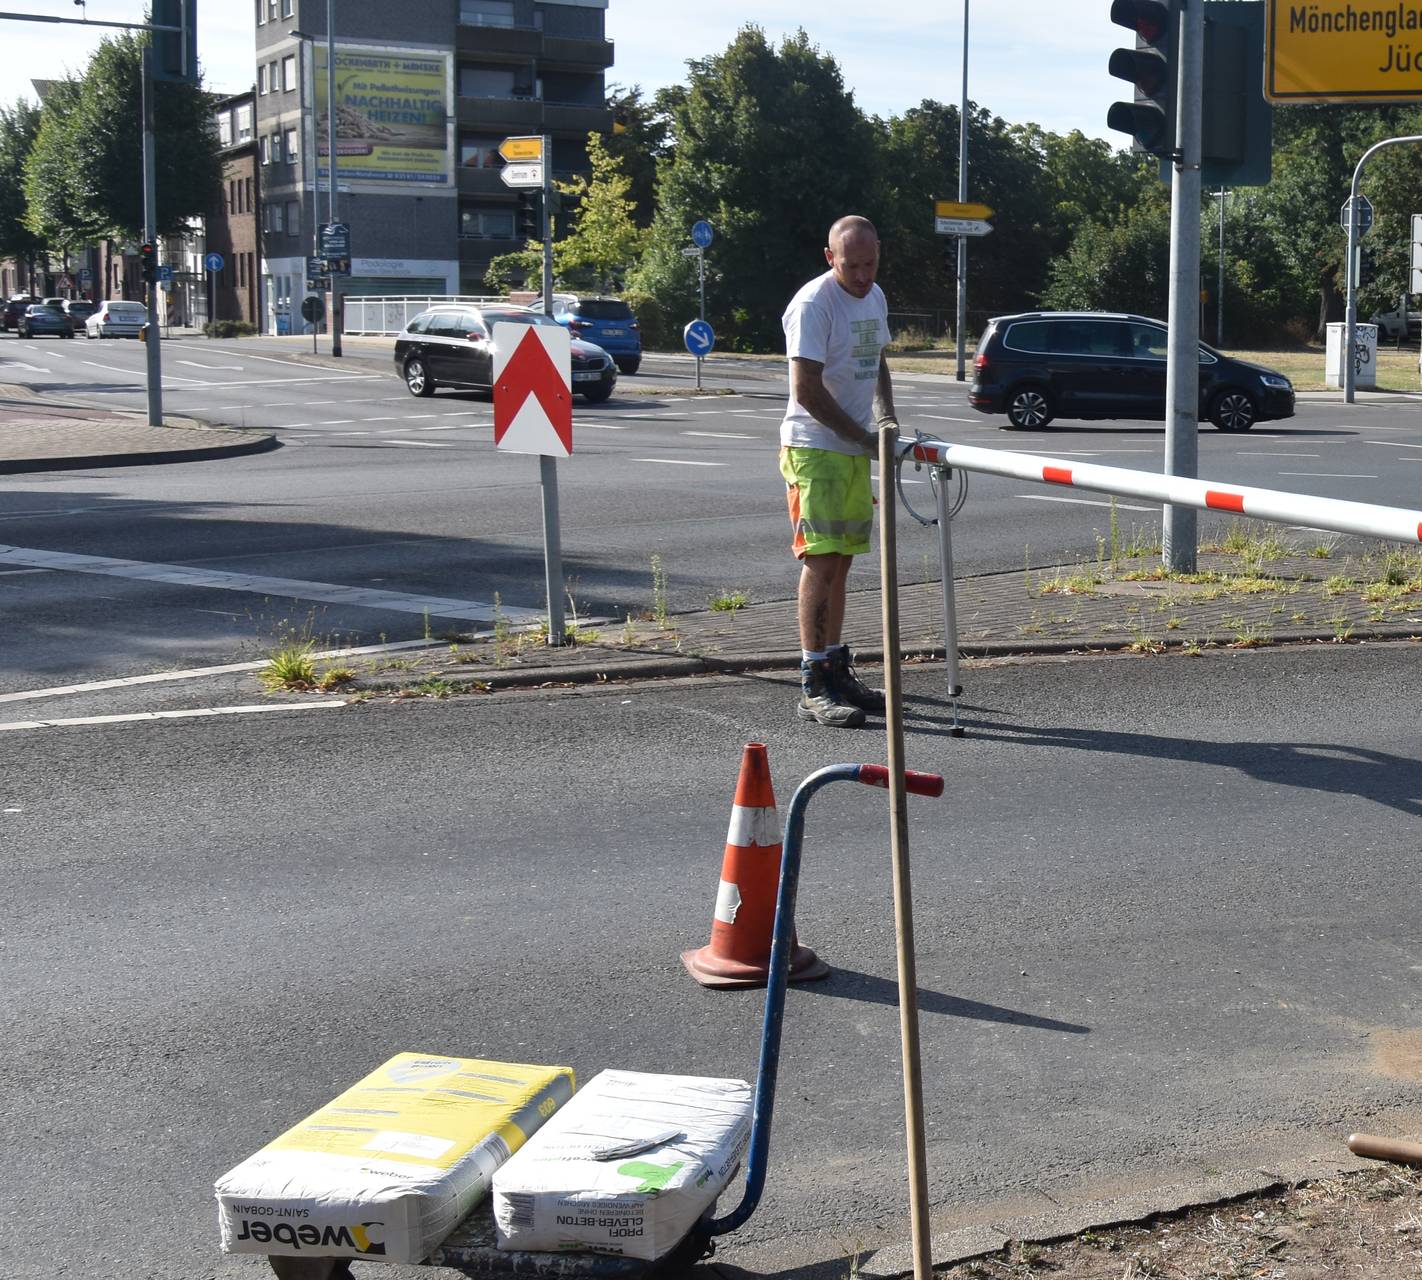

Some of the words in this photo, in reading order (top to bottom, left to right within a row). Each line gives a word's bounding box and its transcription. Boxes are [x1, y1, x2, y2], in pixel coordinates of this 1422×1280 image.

[344, 94, 442, 111] NACHHALTIG
[367, 110, 425, 123] HEIZEN!
[233, 1204, 310, 1219] SAINT-GOBAIN
[556, 1215, 645, 1228] CLEVER-BETON
[237, 1220, 356, 1252] weber
[608, 1227, 645, 1238] PROFI
